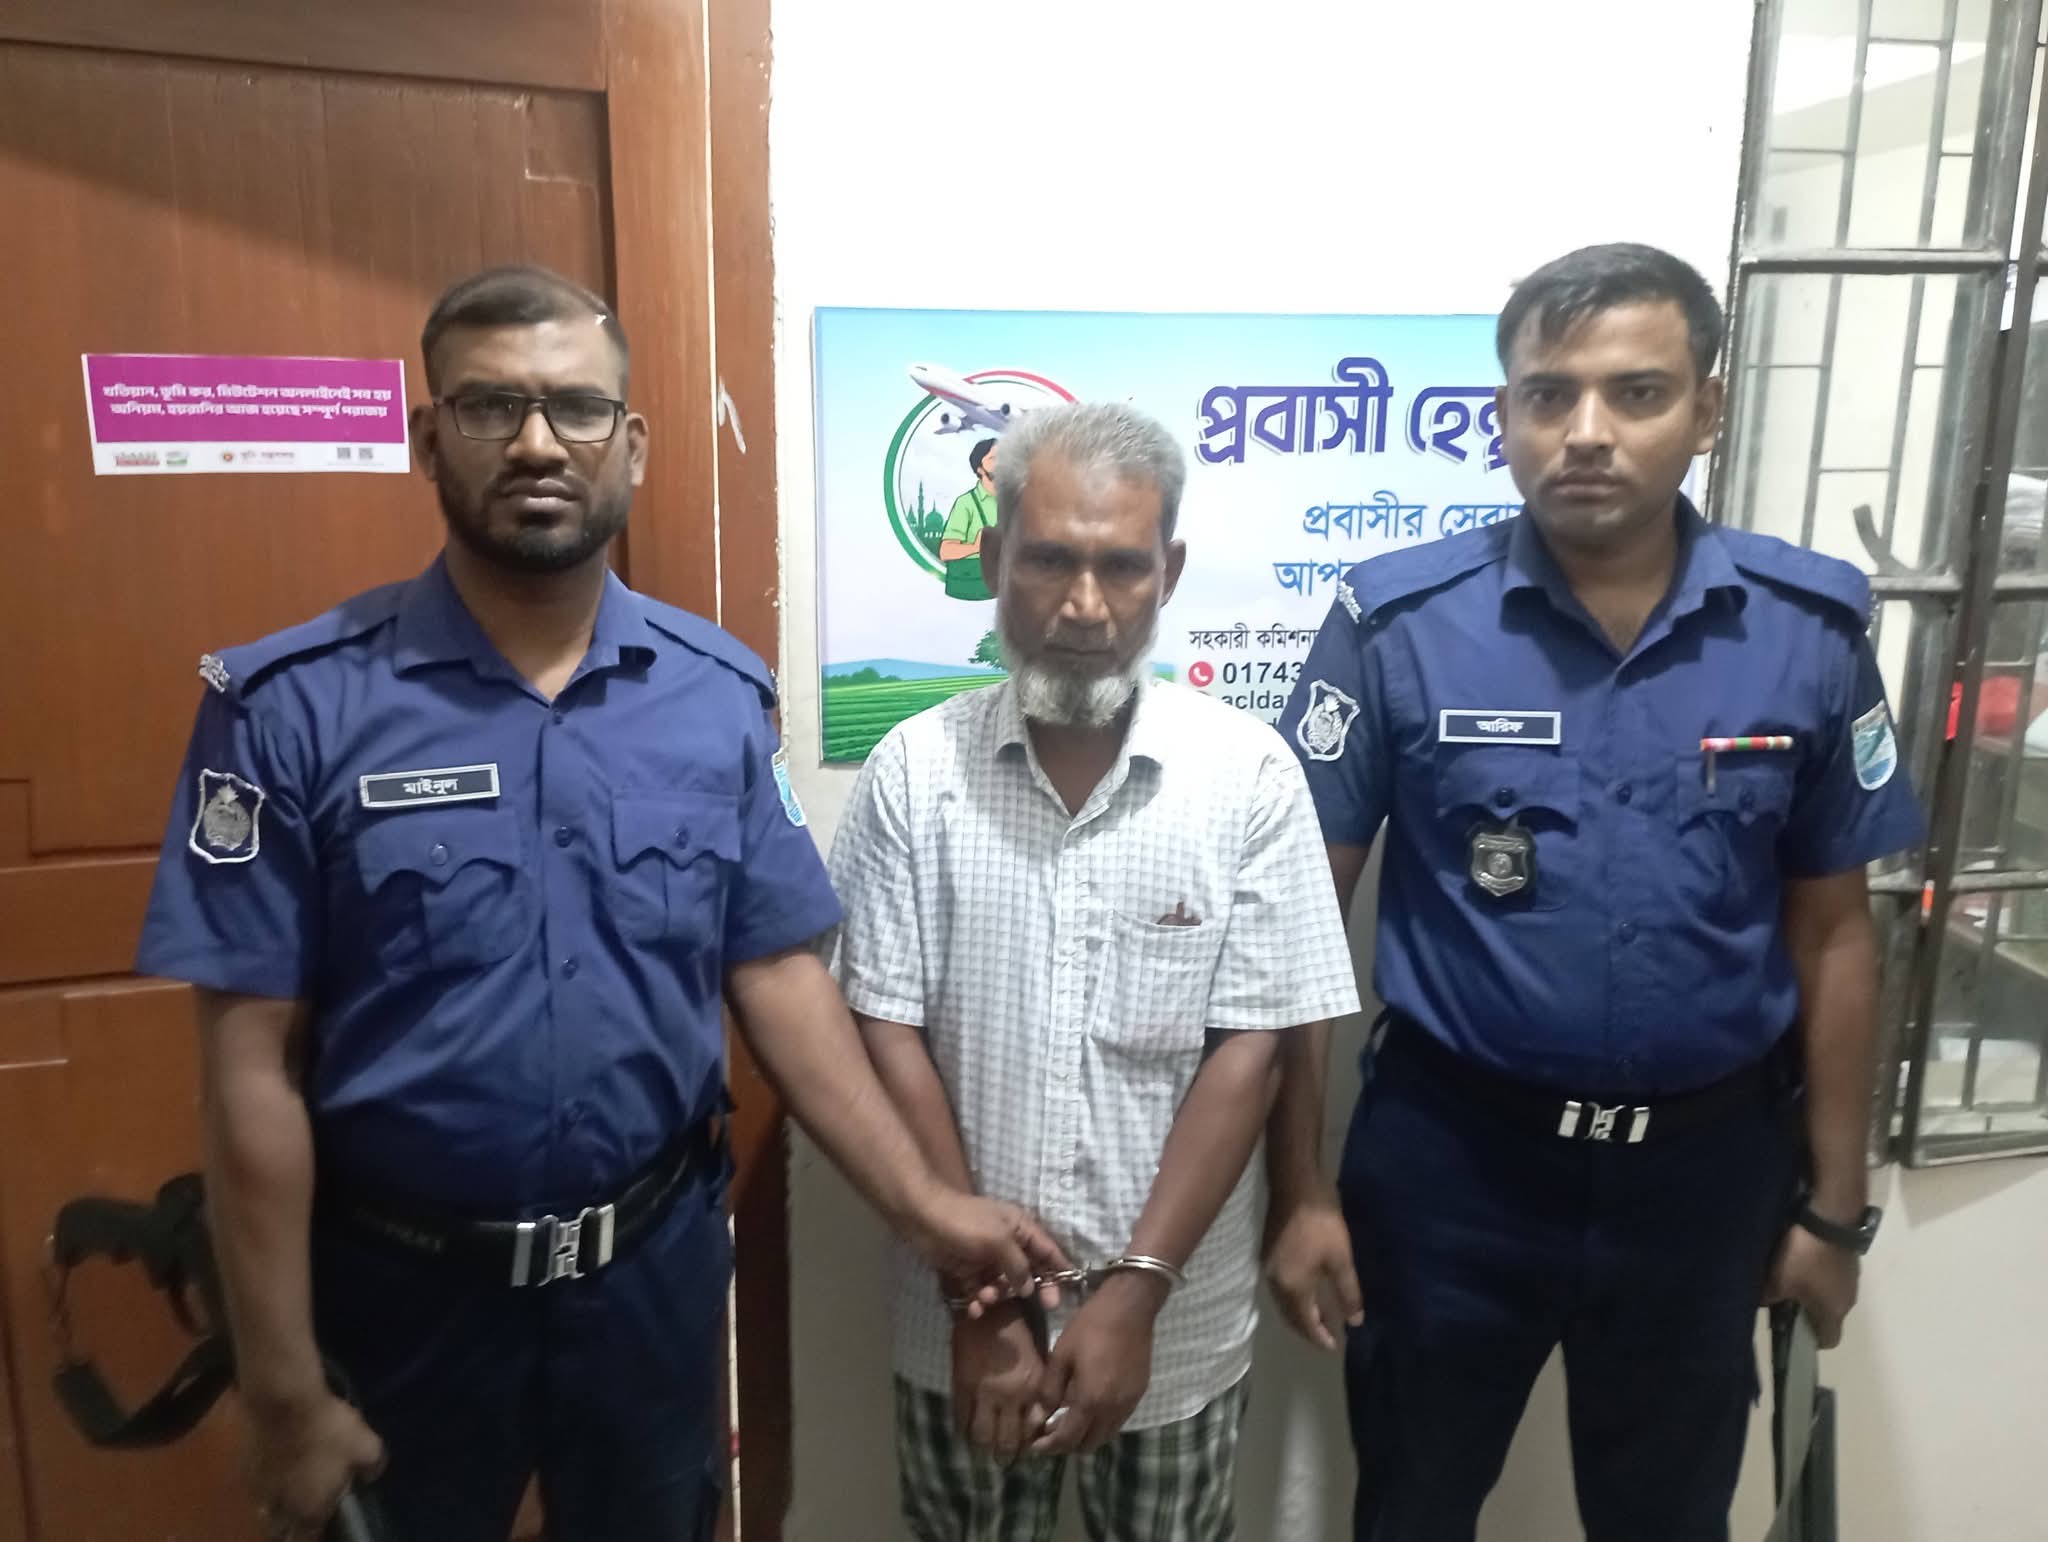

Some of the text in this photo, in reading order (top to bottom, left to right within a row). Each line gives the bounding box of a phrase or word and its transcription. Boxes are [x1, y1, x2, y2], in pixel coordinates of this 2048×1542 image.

[1198, 356, 1394, 464] প্রবাসী
[1302, 490, 1427, 541] প্রবাসীর
[1272, 558, 1358, 597] আপ
[1188, 622, 1250, 650] সহকারী
[1222, 661, 1304, 685] 01743
[1222, 690, 1289, 710] aclda
